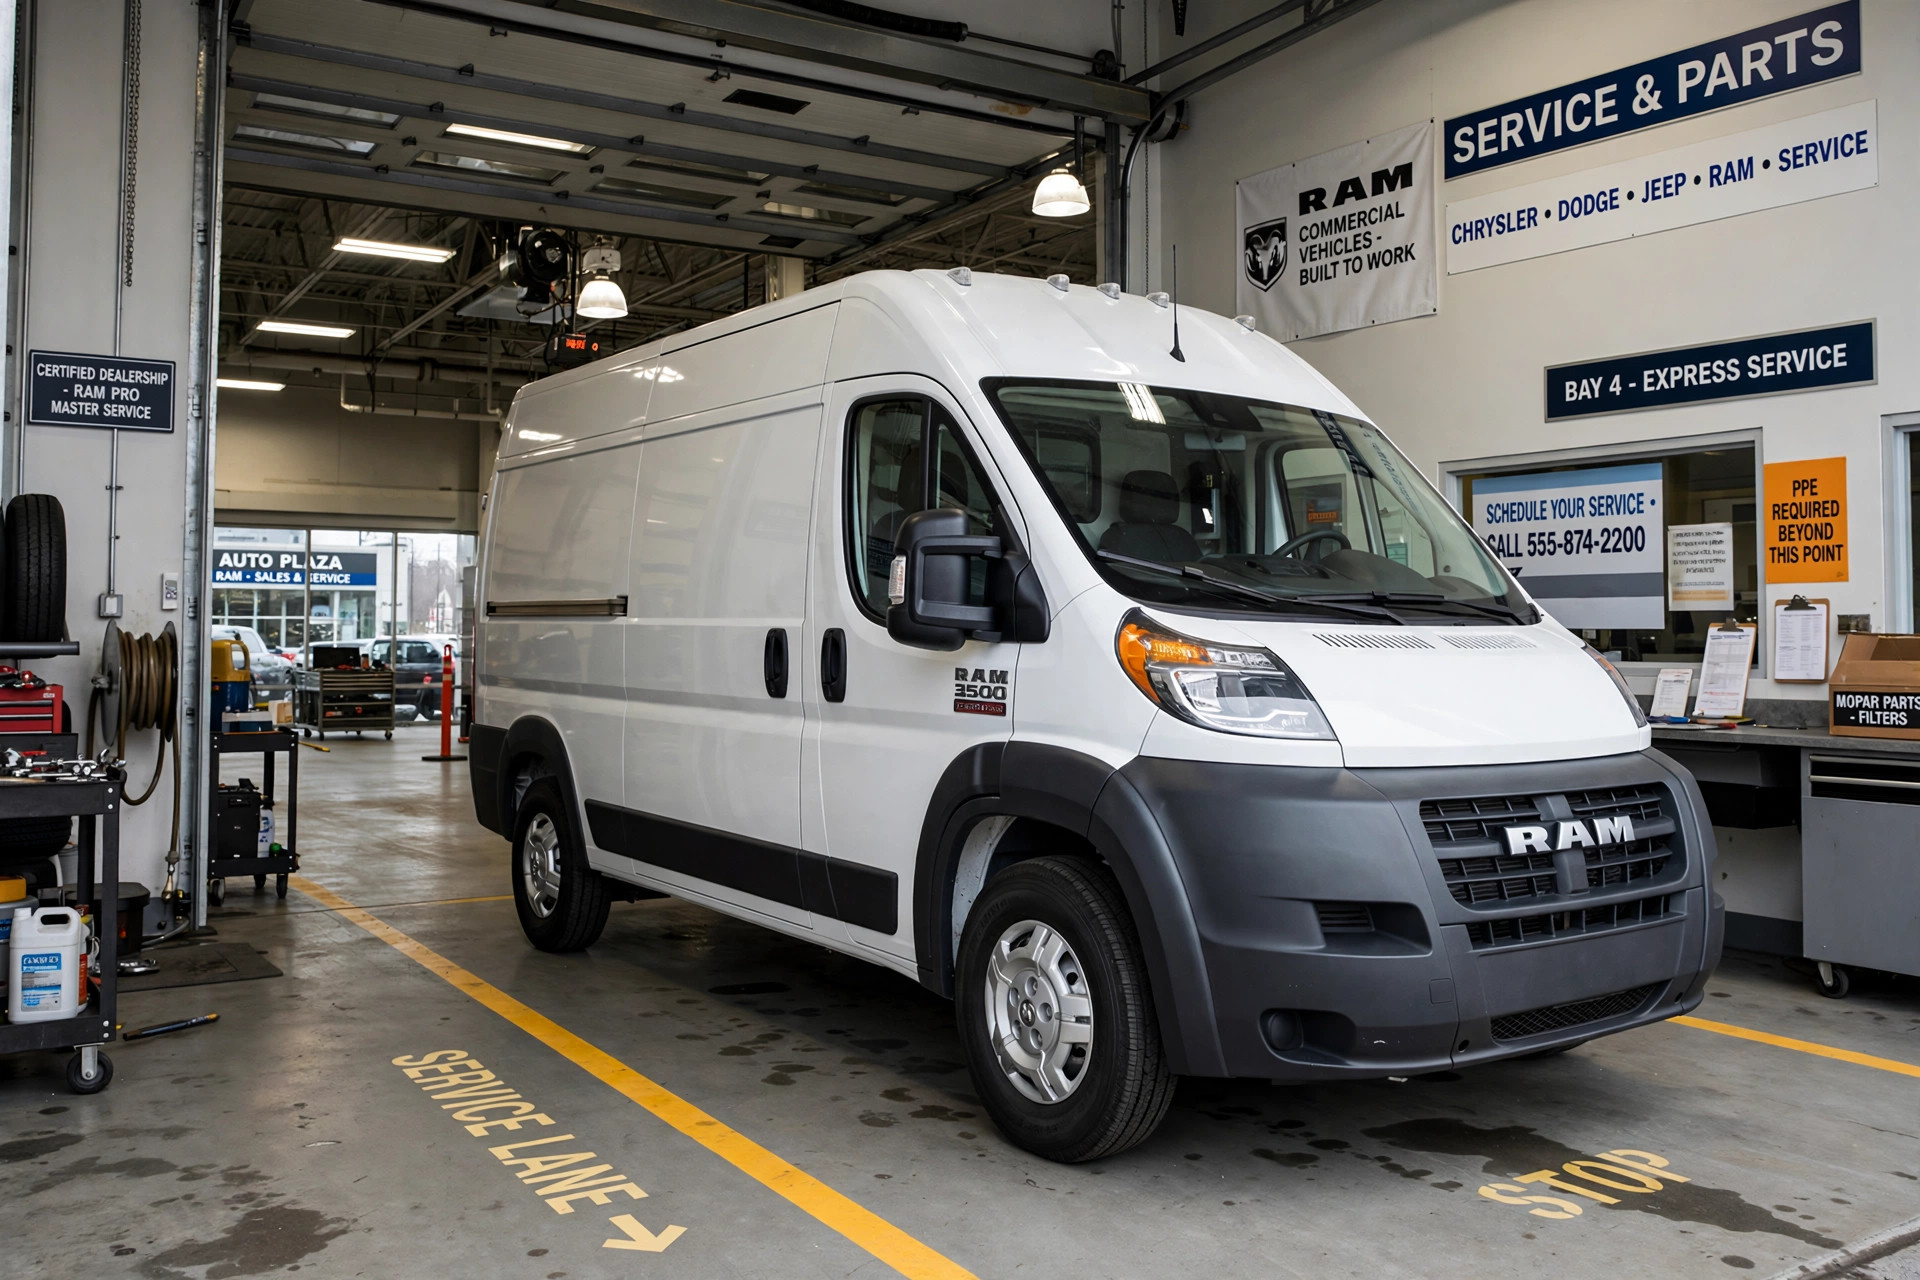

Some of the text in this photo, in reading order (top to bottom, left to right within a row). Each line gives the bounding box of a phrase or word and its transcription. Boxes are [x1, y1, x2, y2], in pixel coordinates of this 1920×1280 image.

[1453, 20, 1844, 163] SERVICE & PARTS
[1299, 161, 1413, 216] RAM
[1451, 206, 1538, 245] CHRYSLER
[1558, 187, 1620, 222] DODGE
[1641, 171, 1687, 203] JEEP
[1709, 156, 1754, 188] RAM
[1778, 129, 1869, 173] SERVICE
[1299, 201, 1405, 243] COMMERCIAL
[1299, 230, 1372, 264] VEHICLES
[1299, 243, 1416, 286] BUILT TO WORK
[37, 363, 169, 385] CERTIFIED DEALERSHIP
[1565, 376, 1603, 402] BAY
[1609, 374, 1622, 396] 4
[1643, 358, 1740, 393] EXPRESS
[1747, 343, 1847, 379] SERVICE
[74, 384, 105, 399] RAM
[111, 387, 140, 402] PRO
[51, 400, 152, 419] MASTER SERVICE
[1792, 478, 1819, 497] PPE
[1486, 500, 1547, 524] SCHEDULE
[1550, 497, 1585, 519] YOUR
[1589, 492, 1644, 516] SERVICE
[1772, 500, 1840, 520] REQUIRED
[1527, 525, 1646, 557] 555-874-2200
[1778, 522, 1834, 542] BEYOND
[218, 552, 343, 570] AUTO PLAZA
[1769, 544, 1844, 564] THIS POINT
[215, 571, 243, 581] RAM
[254, 571, 291, 583] SALES
[293, 572, 302, 582] &
[954, 667, 1009, 685] RAM
[954, 683, 1008, 701] 3500
[1836, 694, 1920, 710] MOPAR PARTS
[1858, 710, 1908, 726] FILTERS
[1504, 815, 1636, 855] RAM
[391, 1049, 649, 1215] SERVICE LANE
[1477, 1149, 1692, 1220] STOP
